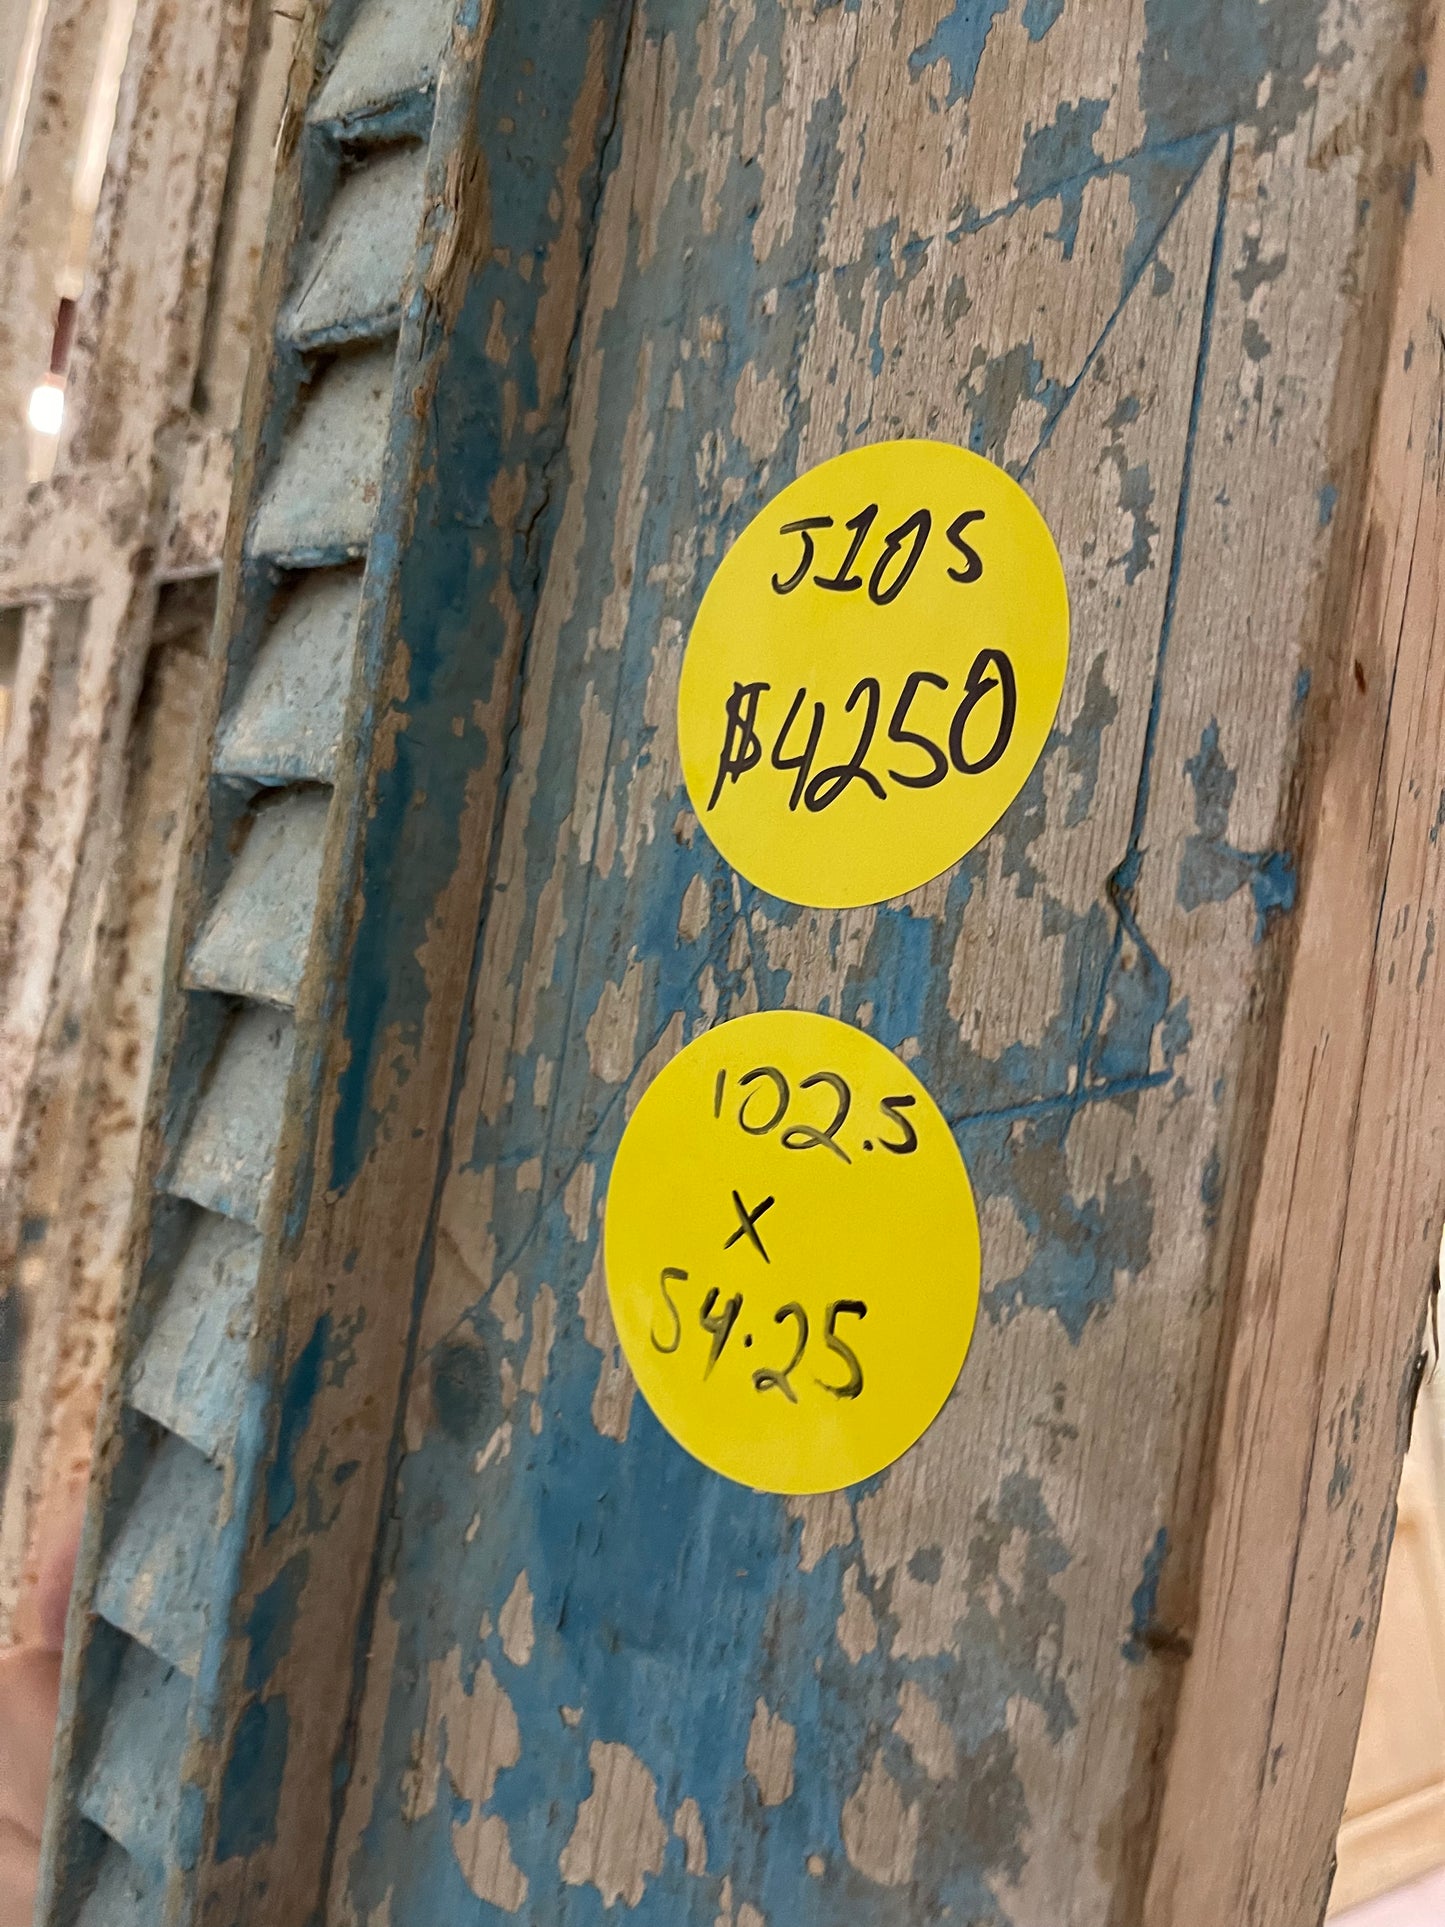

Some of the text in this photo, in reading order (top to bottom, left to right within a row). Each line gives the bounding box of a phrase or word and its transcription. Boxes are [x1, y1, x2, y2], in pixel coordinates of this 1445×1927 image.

[706, 648, 1017, 813] $4250
[713, 1066, 919, 1165] 102.5
[650, 1267, 868, 1404] 54.25
